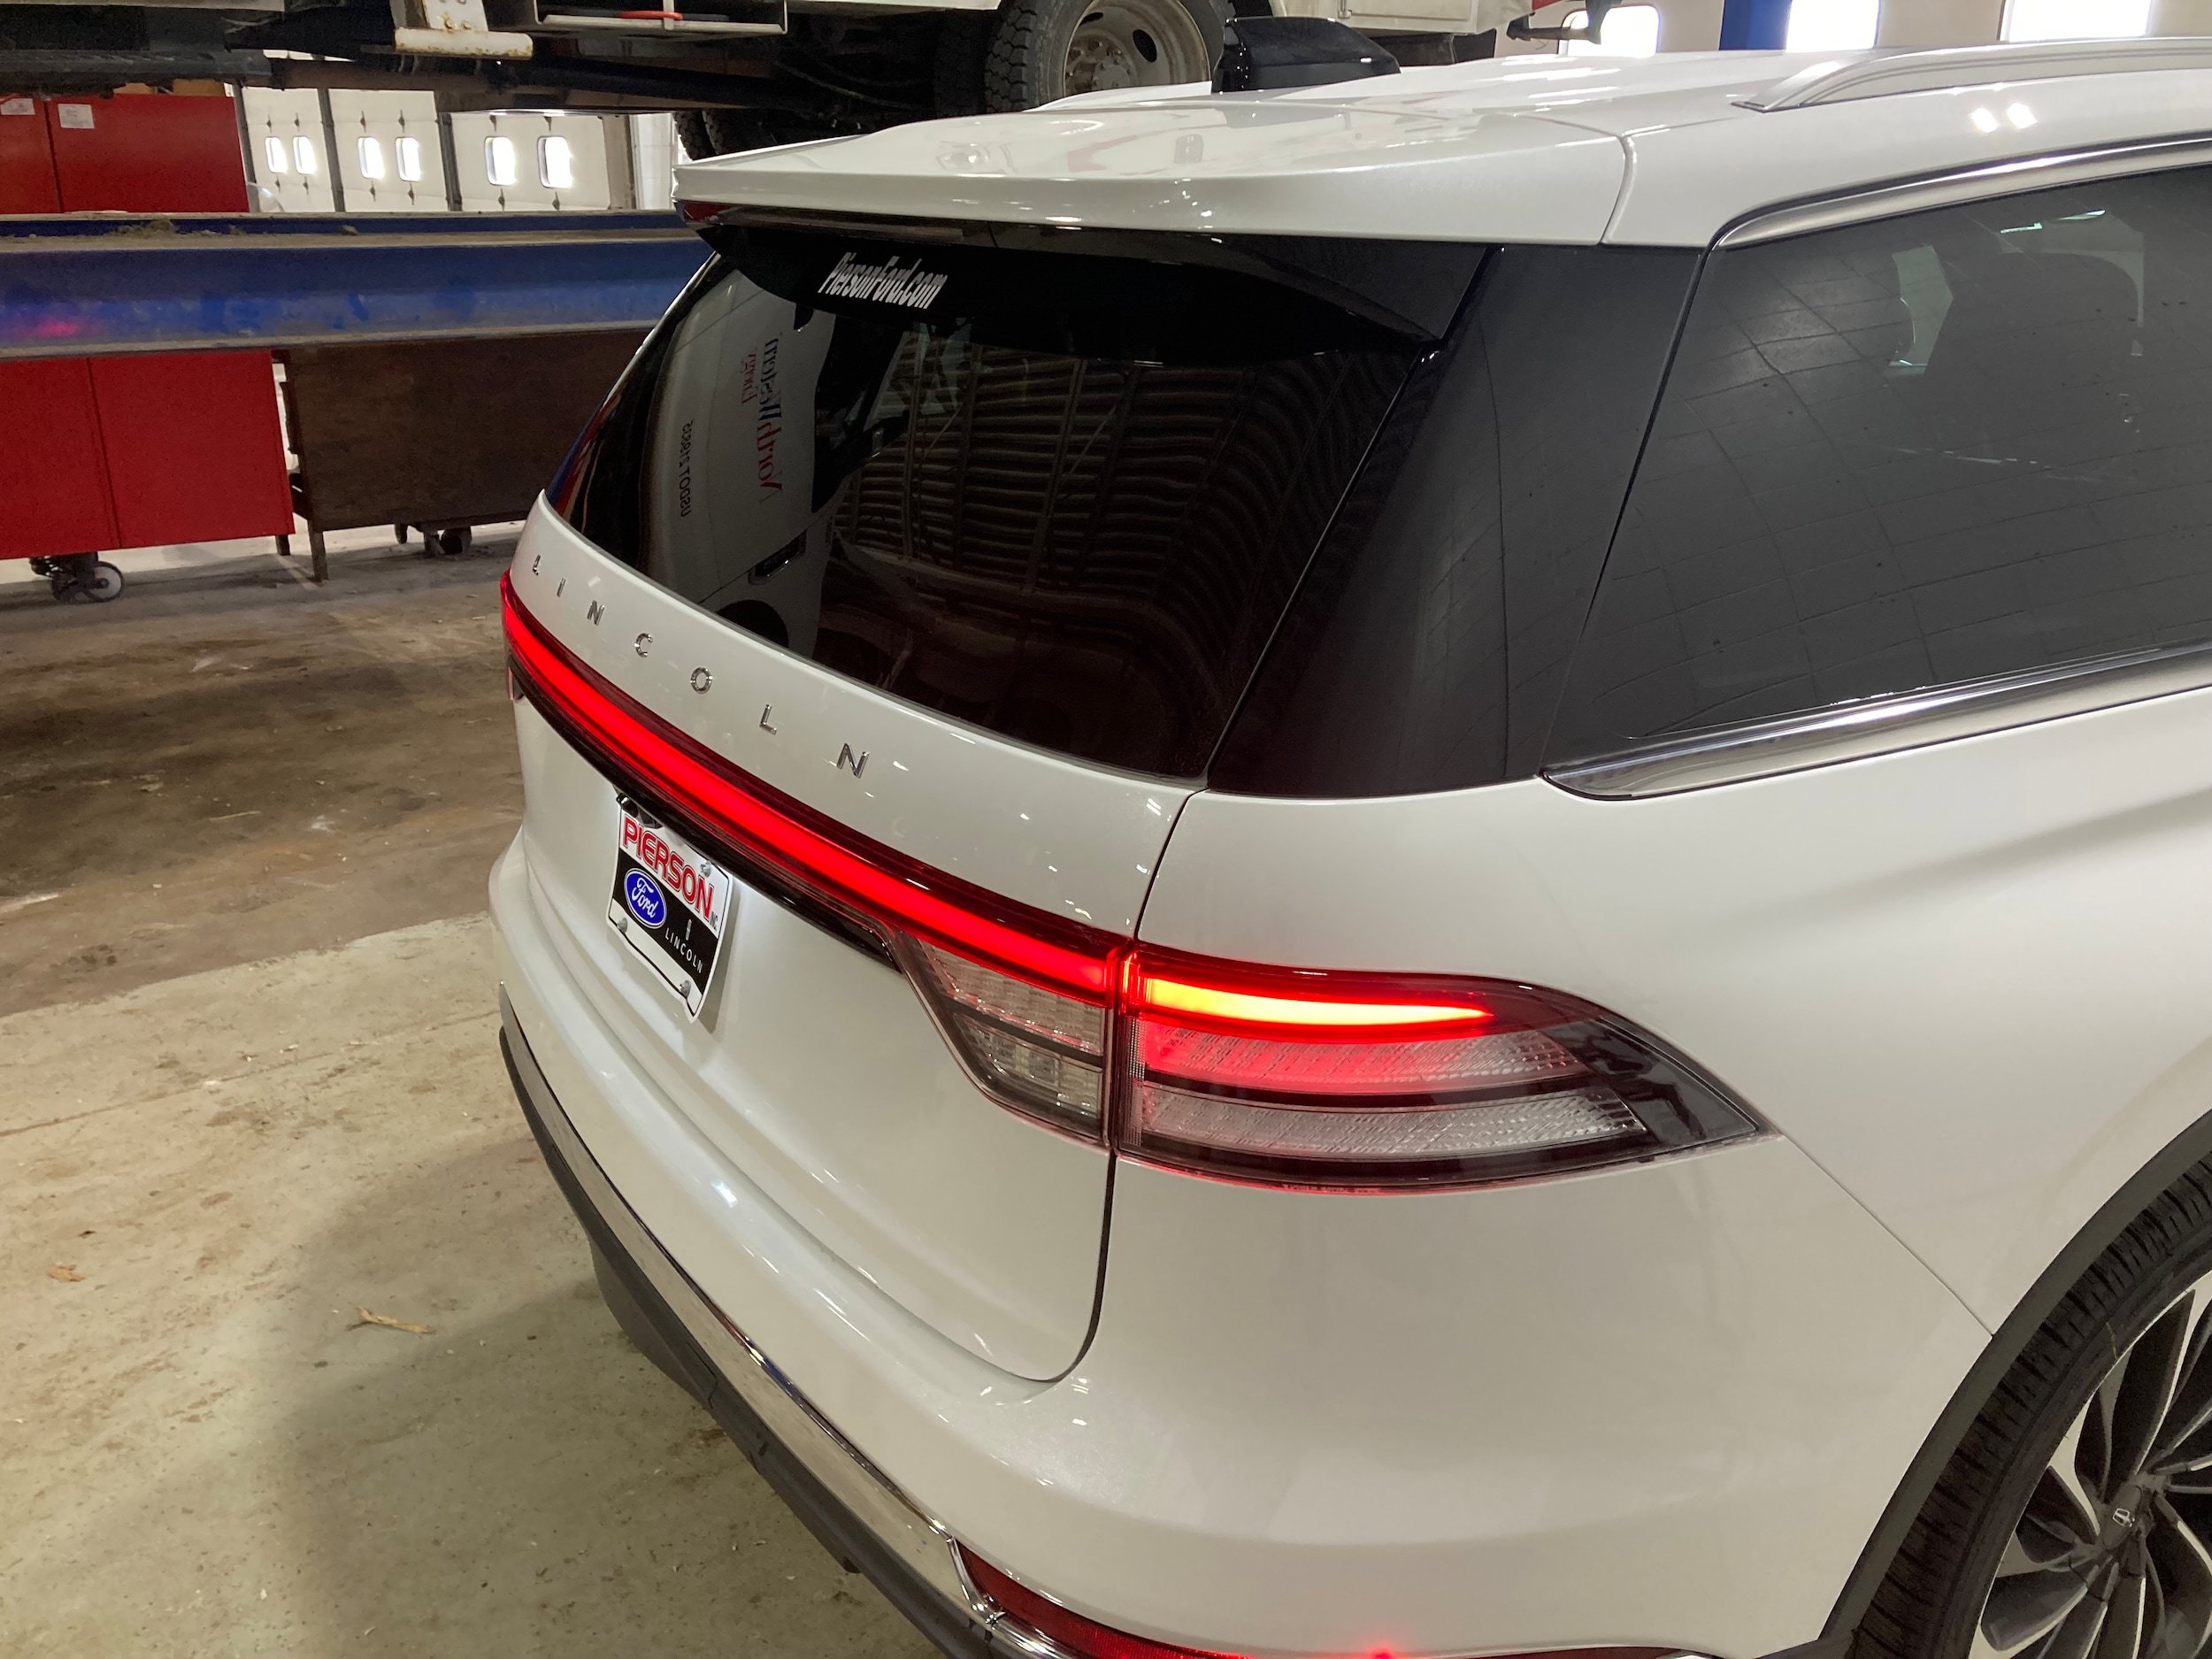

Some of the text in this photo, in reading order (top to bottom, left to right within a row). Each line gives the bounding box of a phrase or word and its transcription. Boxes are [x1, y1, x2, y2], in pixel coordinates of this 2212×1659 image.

[818, 252, 949, 309] PiersonFord.com
[533, 554, 871, 779] LINCOLN
[623, 815, 715, 922] PIERSON
[631, 877, 660, 918] Ford
[664, 927, 703, 974] LINCOLN
